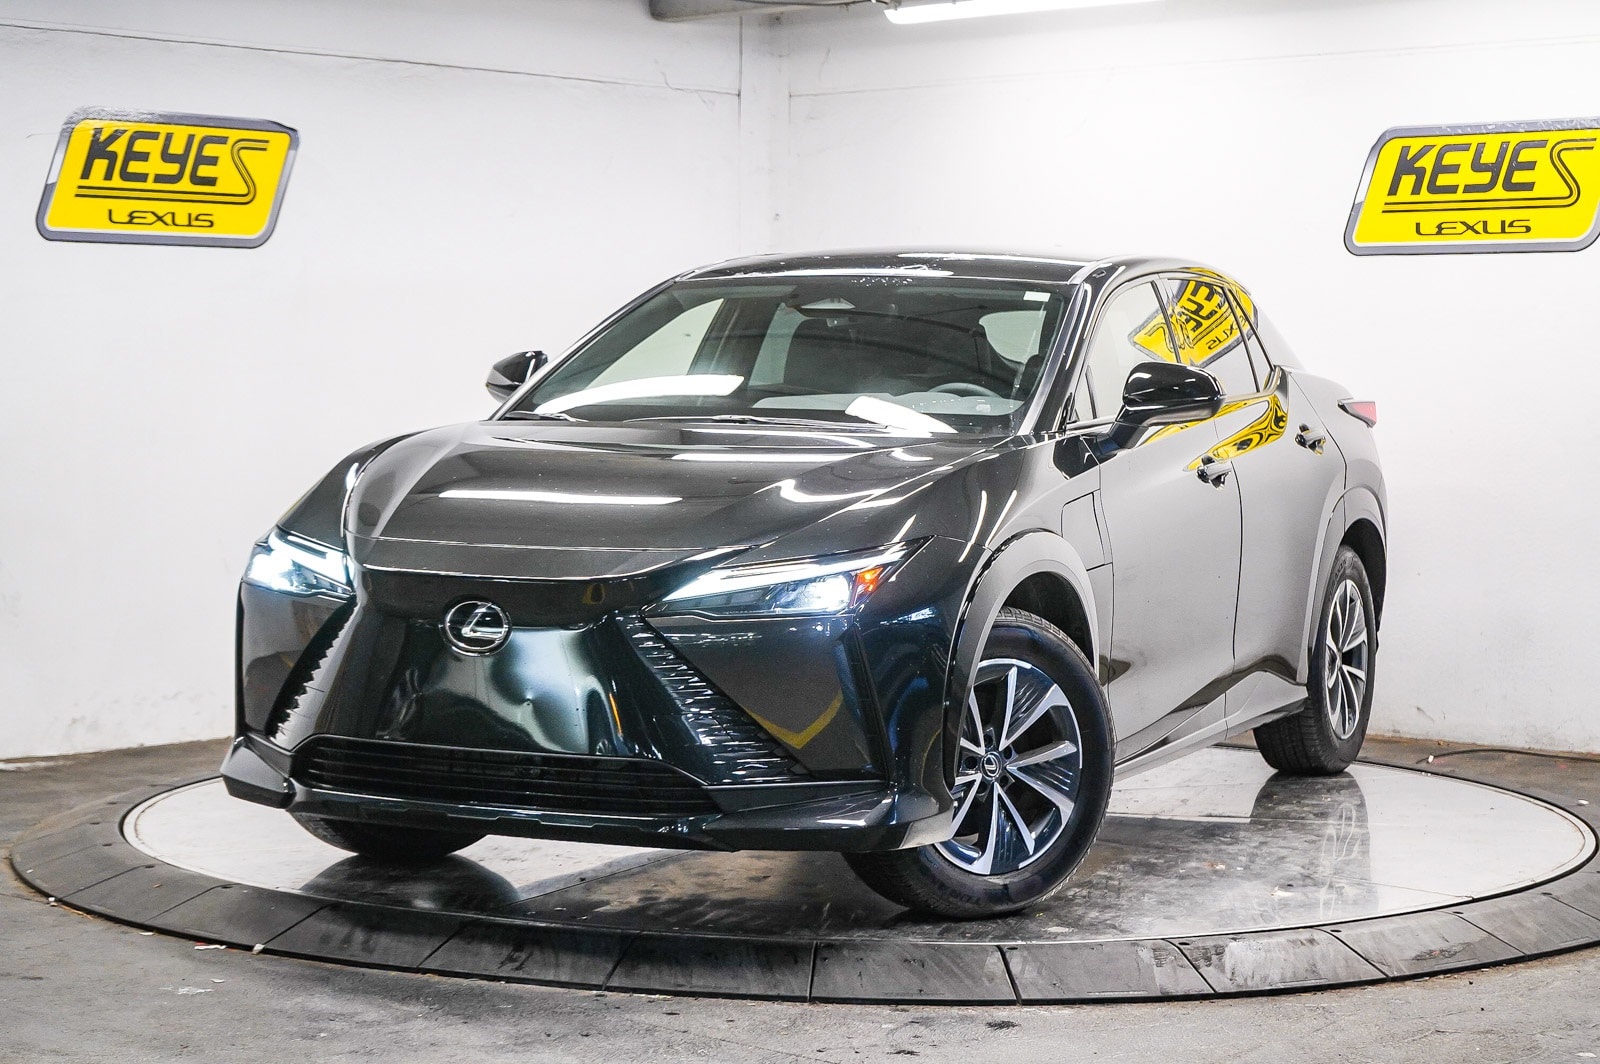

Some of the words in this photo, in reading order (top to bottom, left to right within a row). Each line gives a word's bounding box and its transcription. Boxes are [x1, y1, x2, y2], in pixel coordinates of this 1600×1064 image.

[74, 127, 270, 206] KEYES
[1381, 138, 1598, 214] KEYES
[108, 208, 215, 228] LEXUS
[1415, 219, 1532, 236] LEXUS
